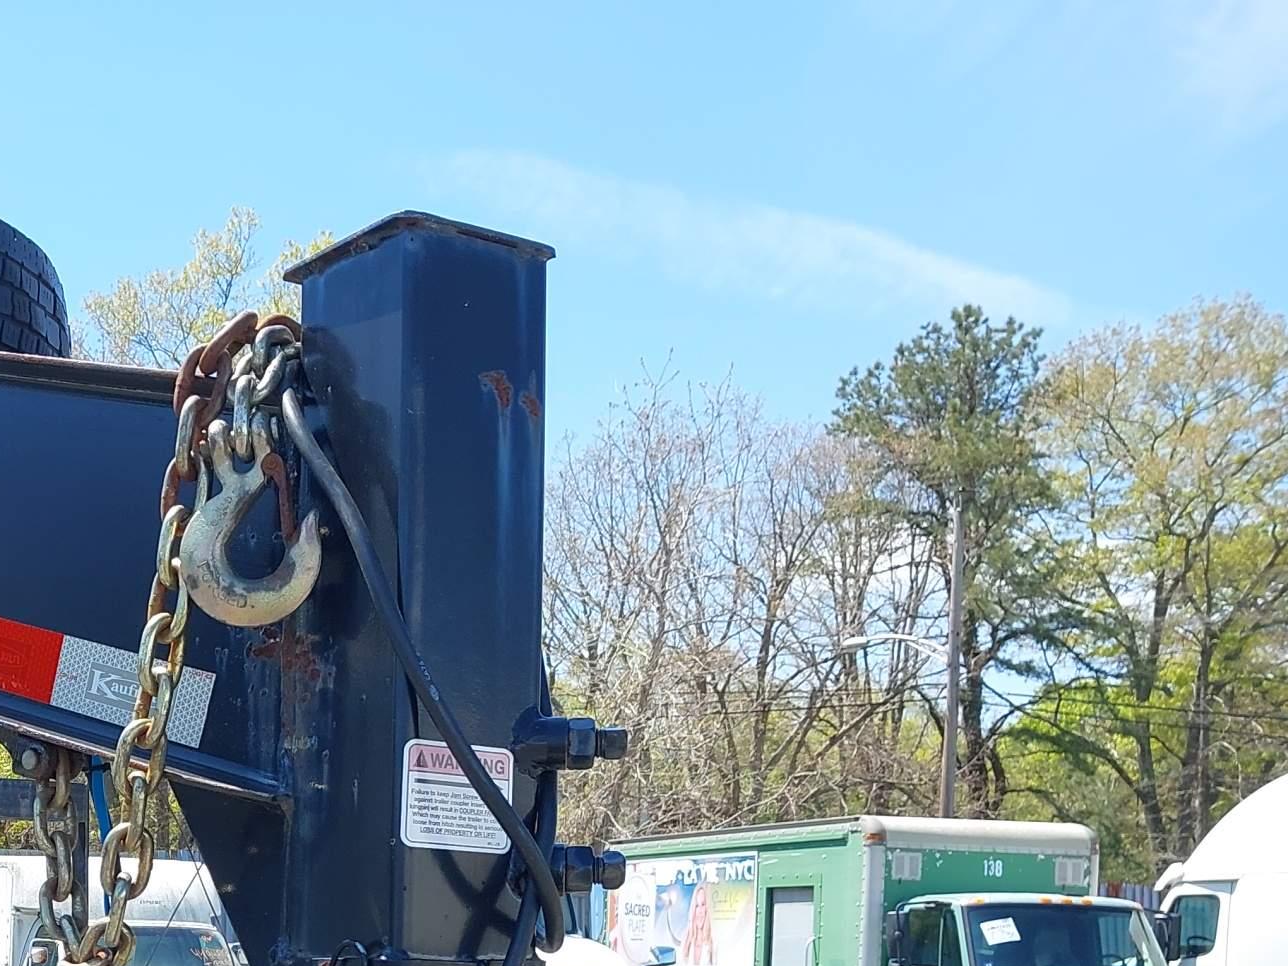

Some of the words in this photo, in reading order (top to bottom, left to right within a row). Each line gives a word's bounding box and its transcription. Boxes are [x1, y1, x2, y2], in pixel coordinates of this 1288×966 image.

[87, 669, 141, 699] Kauf
[430, 752, 505, 775] WANG
[624, 901, 651, 917] SACRED
